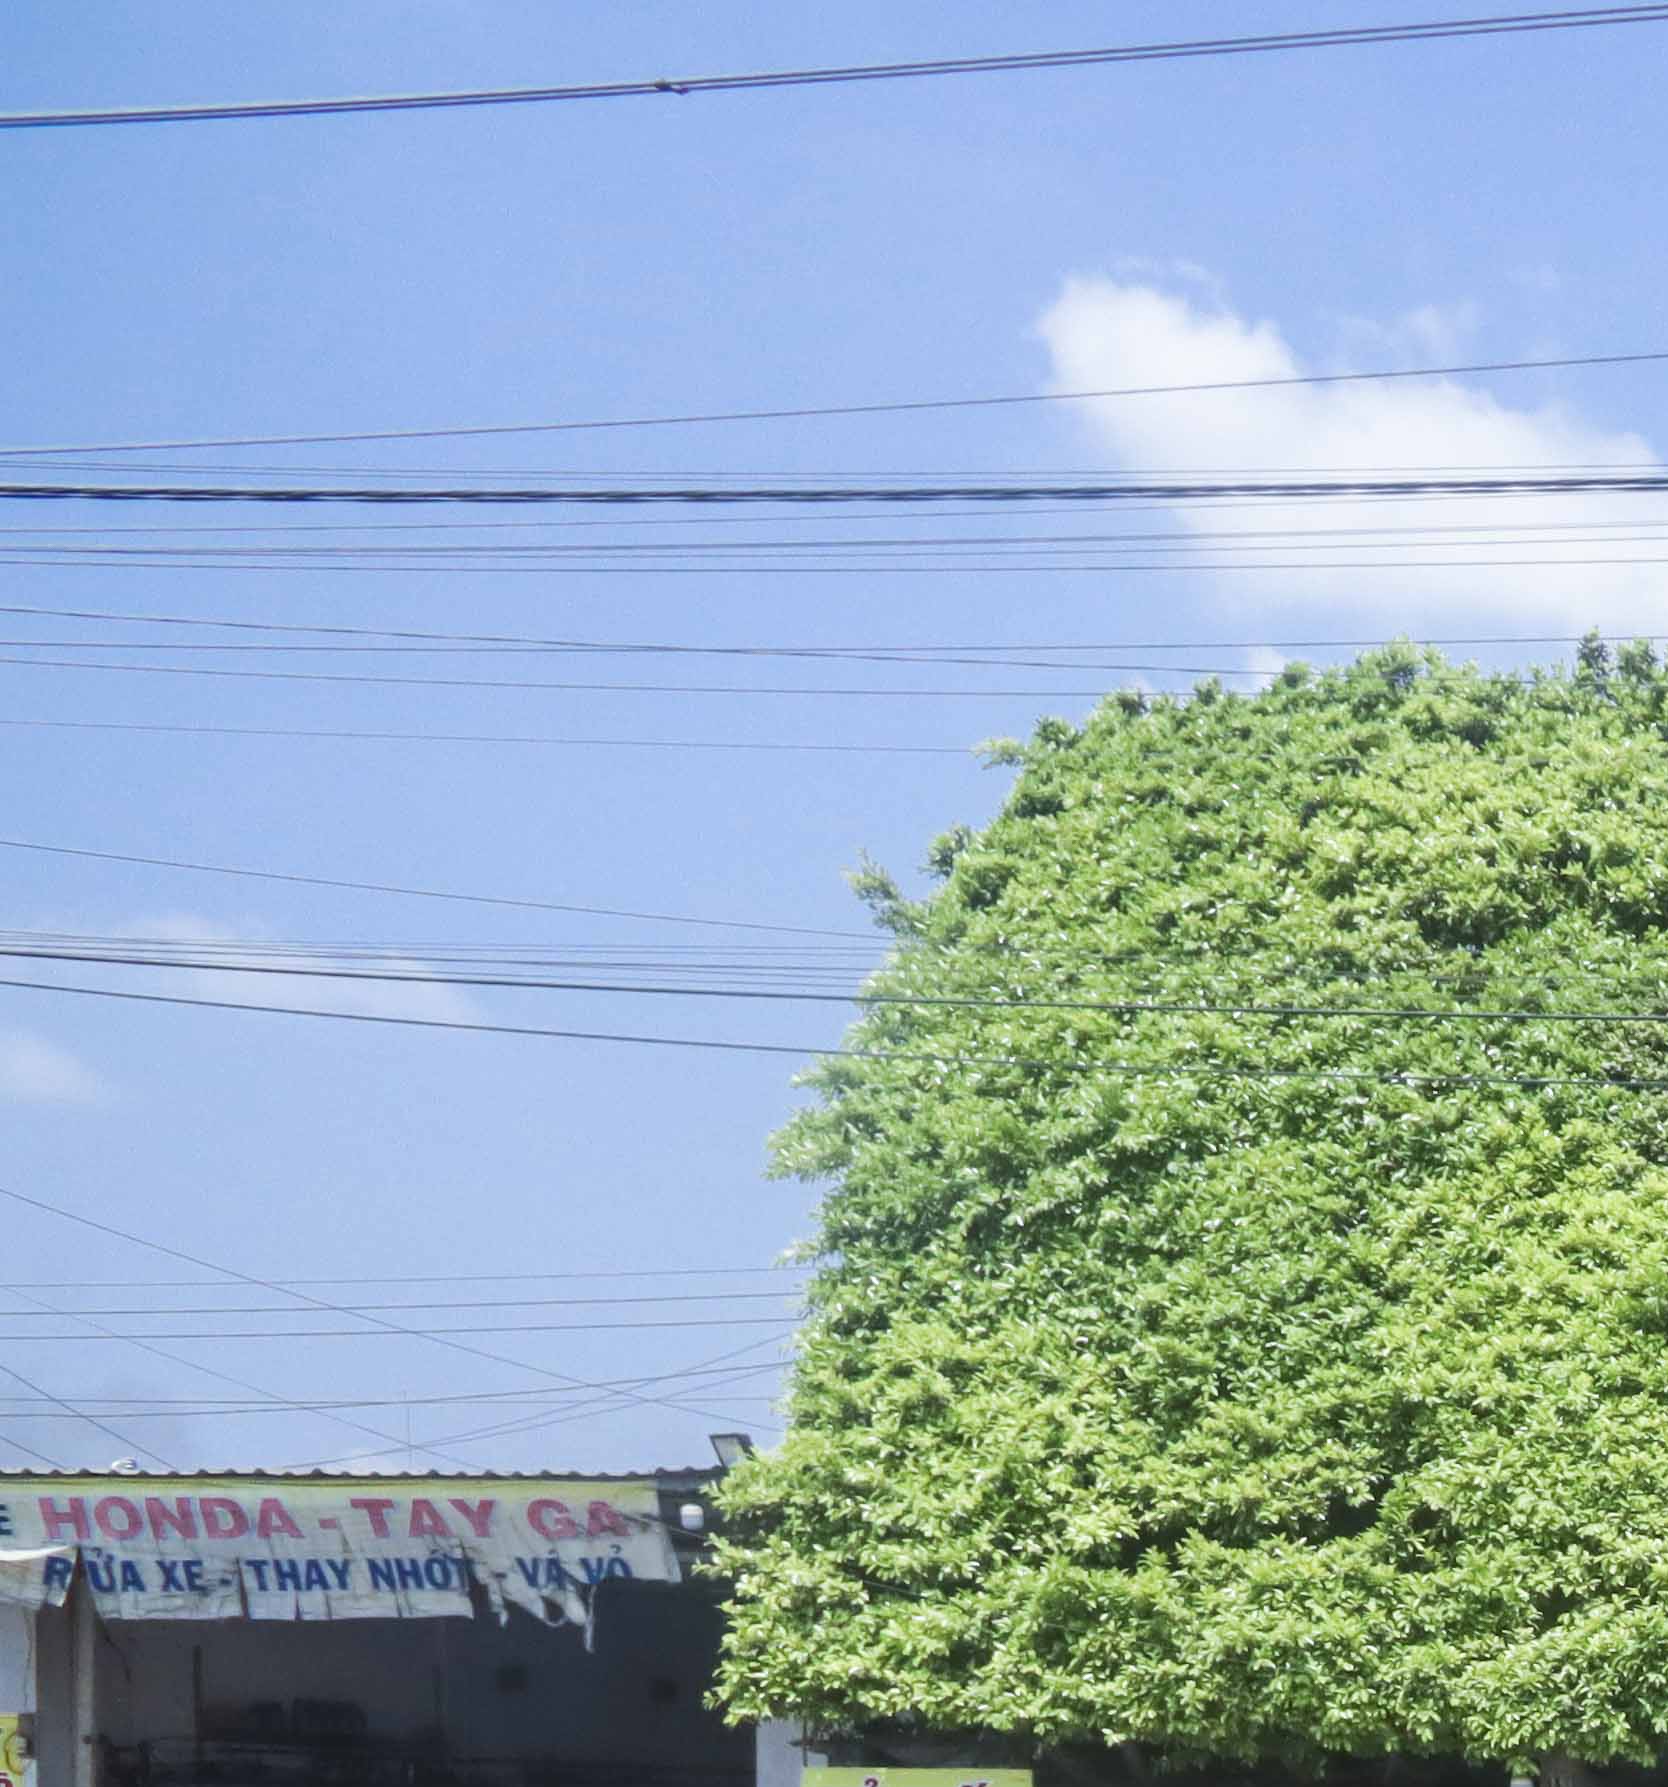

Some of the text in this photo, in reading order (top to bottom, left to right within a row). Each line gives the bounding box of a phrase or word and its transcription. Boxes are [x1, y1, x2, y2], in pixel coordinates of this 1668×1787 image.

[39, 1496, 305, 1540] HONDA
[350, 1498, 496, 1538] TAY
[527, 1499, 631, 1539] GA
[155, 1560, 206, 1592] XE
[246, 1559, 354, 1591] THAY
